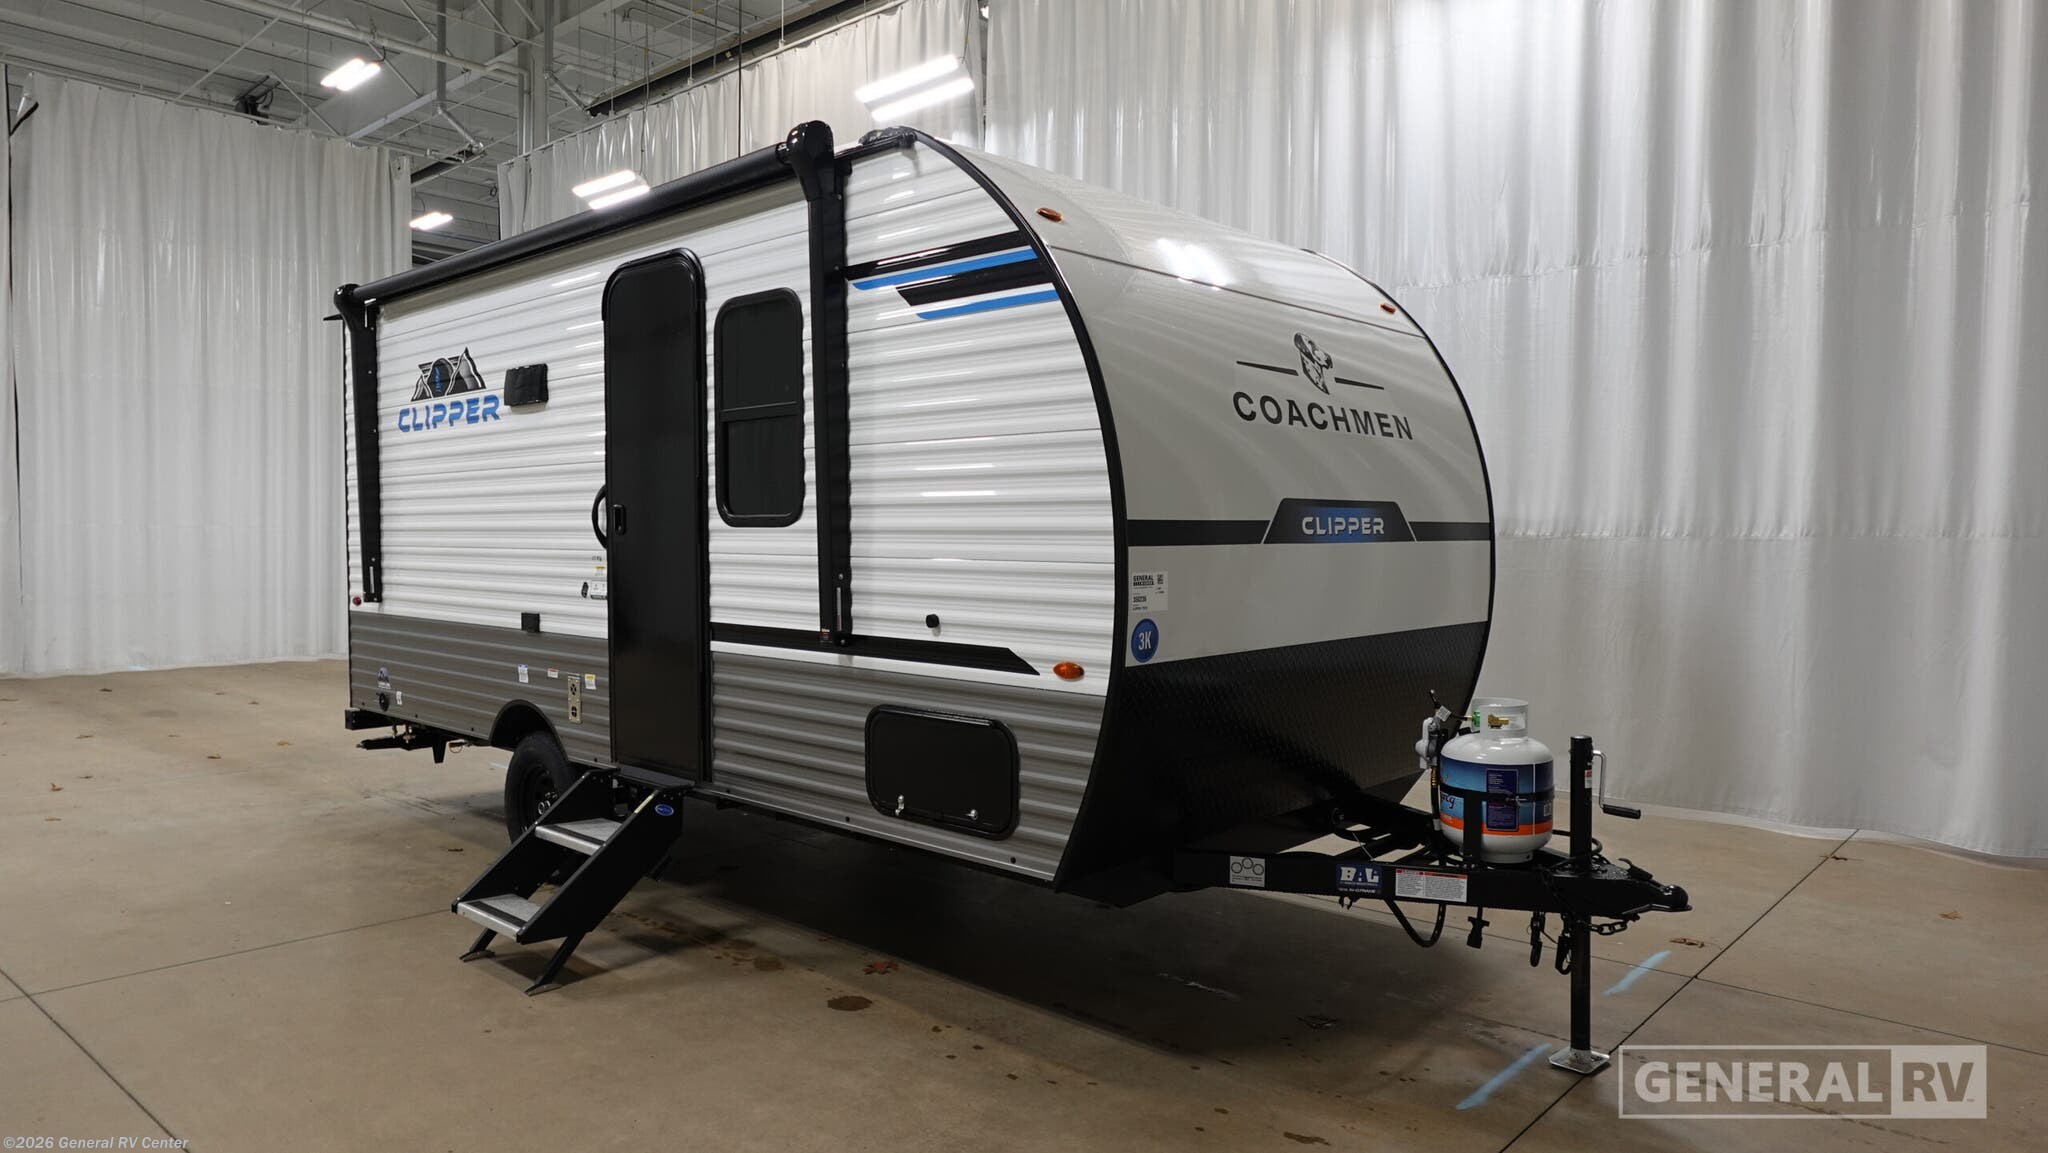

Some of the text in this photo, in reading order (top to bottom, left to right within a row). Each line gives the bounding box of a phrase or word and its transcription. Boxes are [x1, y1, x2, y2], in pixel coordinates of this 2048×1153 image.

[398, 395, 501, 432] CLIPPER
[1233, 391, 1414, 440] COACHMEN
[1301, 516, 1385, 535] CLIPPER
[1138, 631, 1152, 650] 3K
[1340, 866, 1379, 883] BAL
